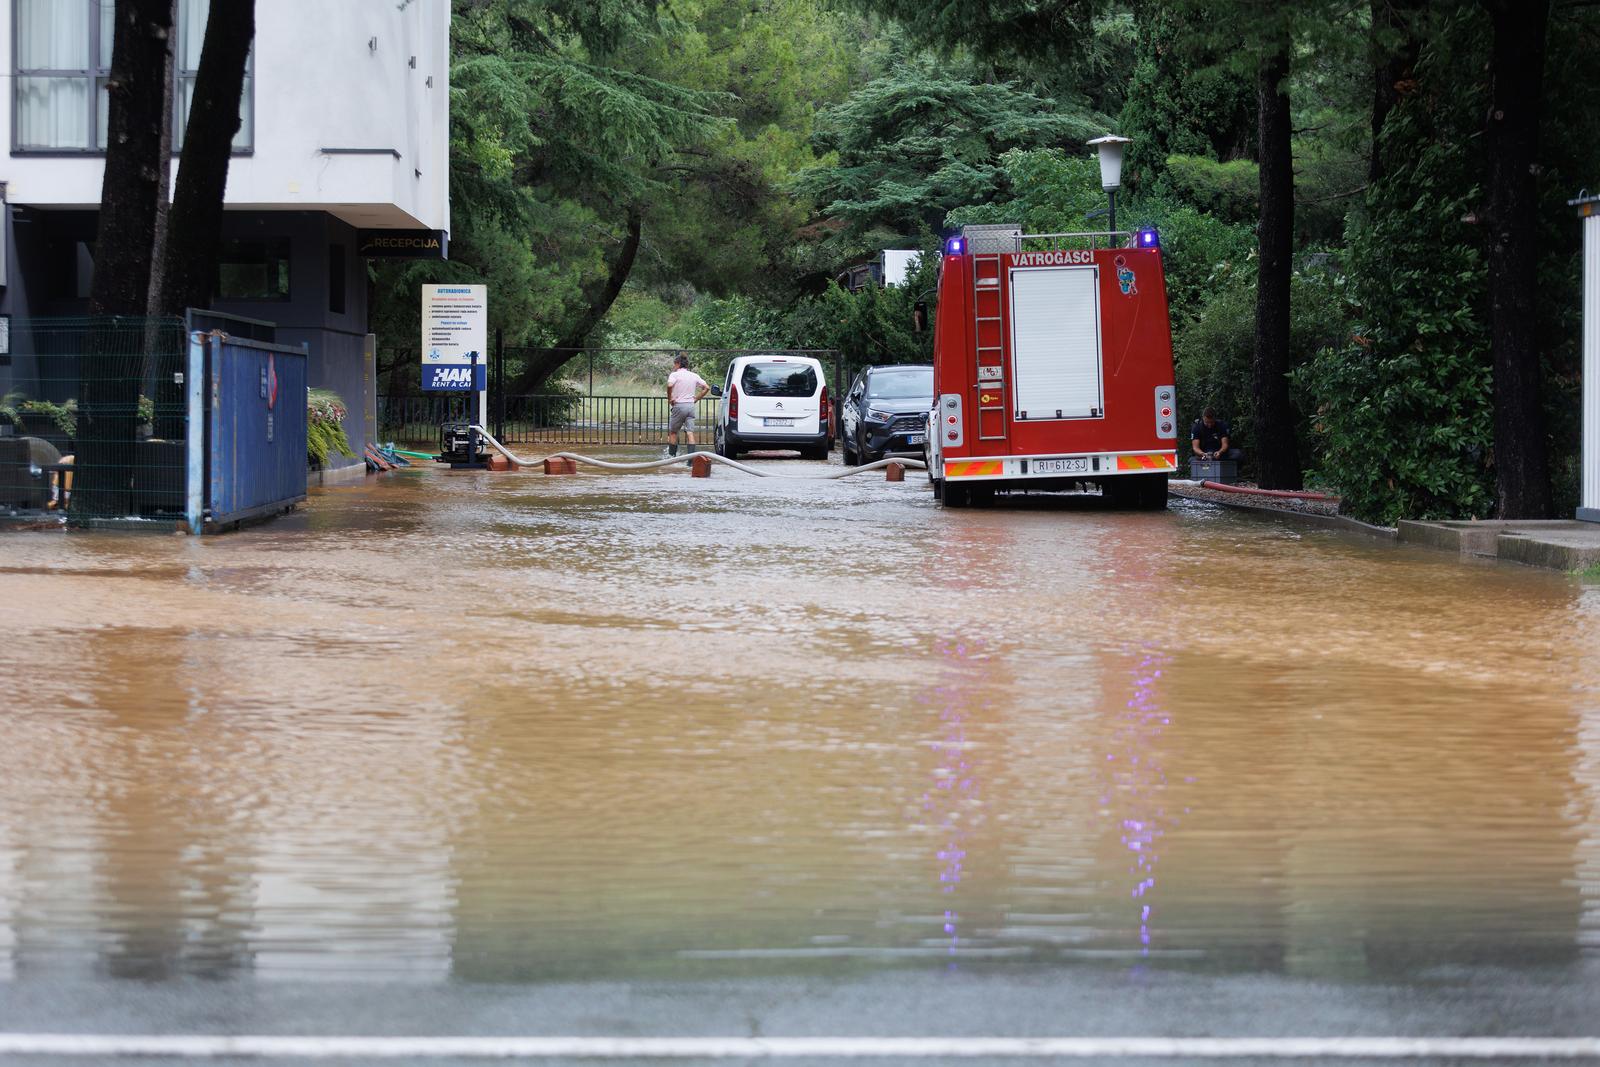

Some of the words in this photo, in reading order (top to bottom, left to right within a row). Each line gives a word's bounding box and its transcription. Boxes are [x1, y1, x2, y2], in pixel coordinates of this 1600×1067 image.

[374, 238, 440, 249] RECEPCIJA
[1010, 251, 1095, 266] VATROGASCI
[1039, 461, 1048, 470] RI
[1055, 460, 1086, 470] 612-SJ
